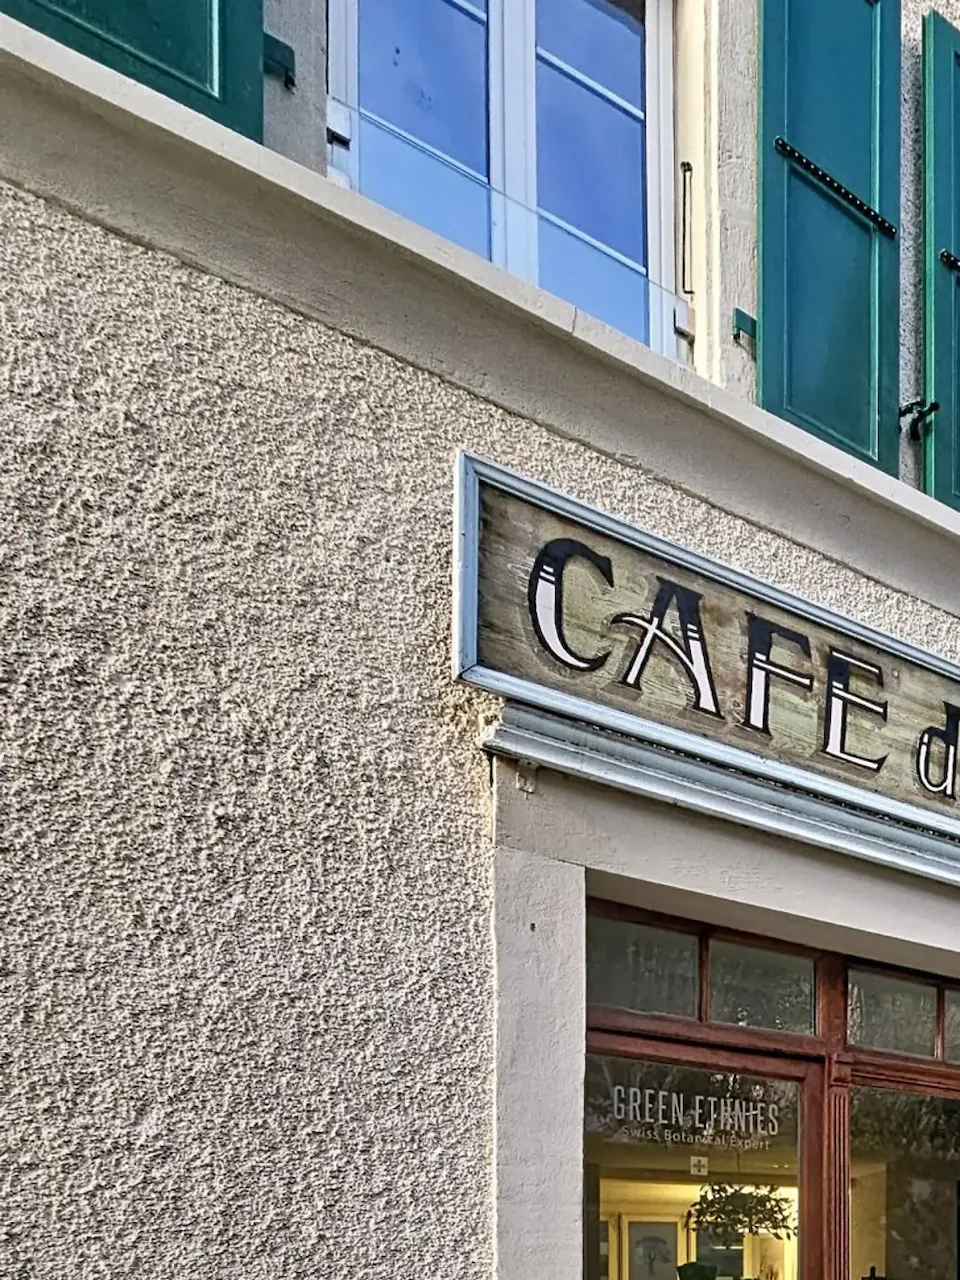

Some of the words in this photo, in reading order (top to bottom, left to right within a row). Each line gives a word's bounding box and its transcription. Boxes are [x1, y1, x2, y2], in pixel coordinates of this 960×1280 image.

[528, 537, 888, 772] CAFE
[613, 1085, 684, 1126] GREEN
[695, 1095, 778, 1135] ETHNIES
[622, 1126, 659, 1140] Swiss
[730, 1134, 769, 1150] Expert
